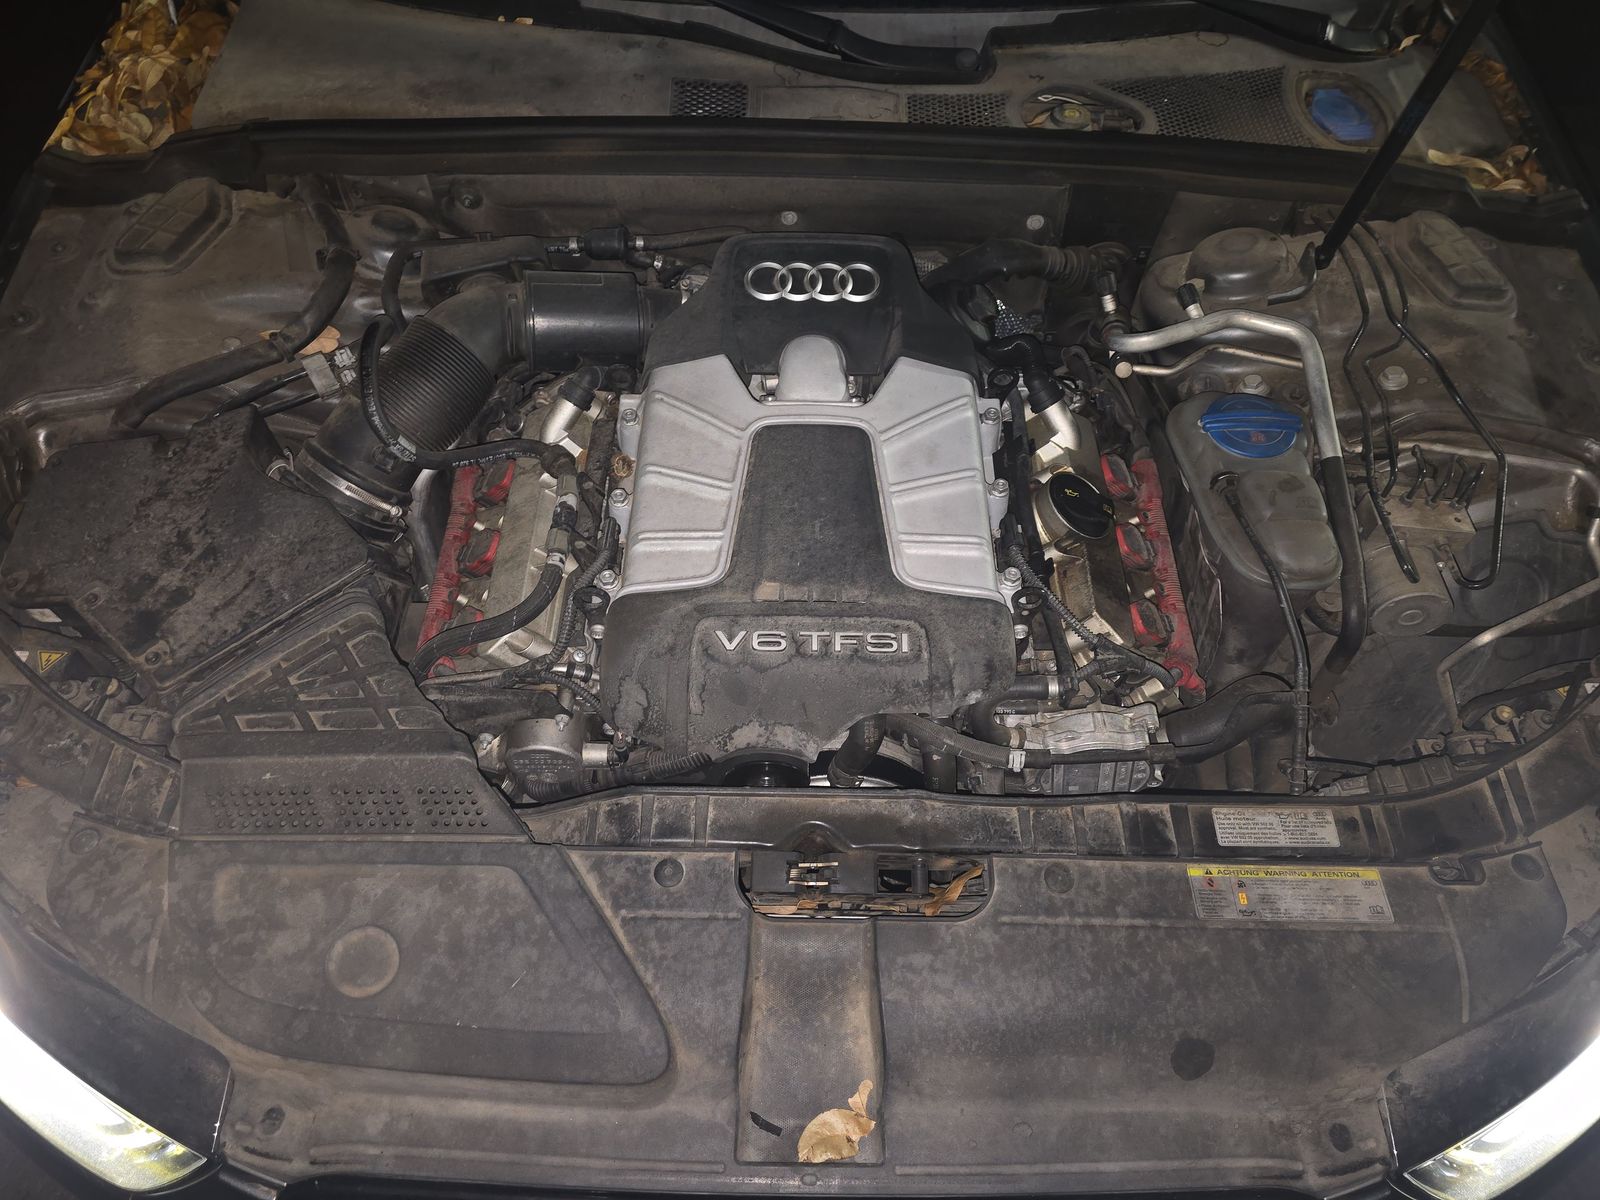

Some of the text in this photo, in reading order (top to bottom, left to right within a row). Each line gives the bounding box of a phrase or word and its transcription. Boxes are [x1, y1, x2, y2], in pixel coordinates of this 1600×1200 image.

[714, 630, 909, 654] V6 TFSI
[1216, 868, 1259, 876] ACHTUNG
[1263, 869, 1307, 877] WARNING
